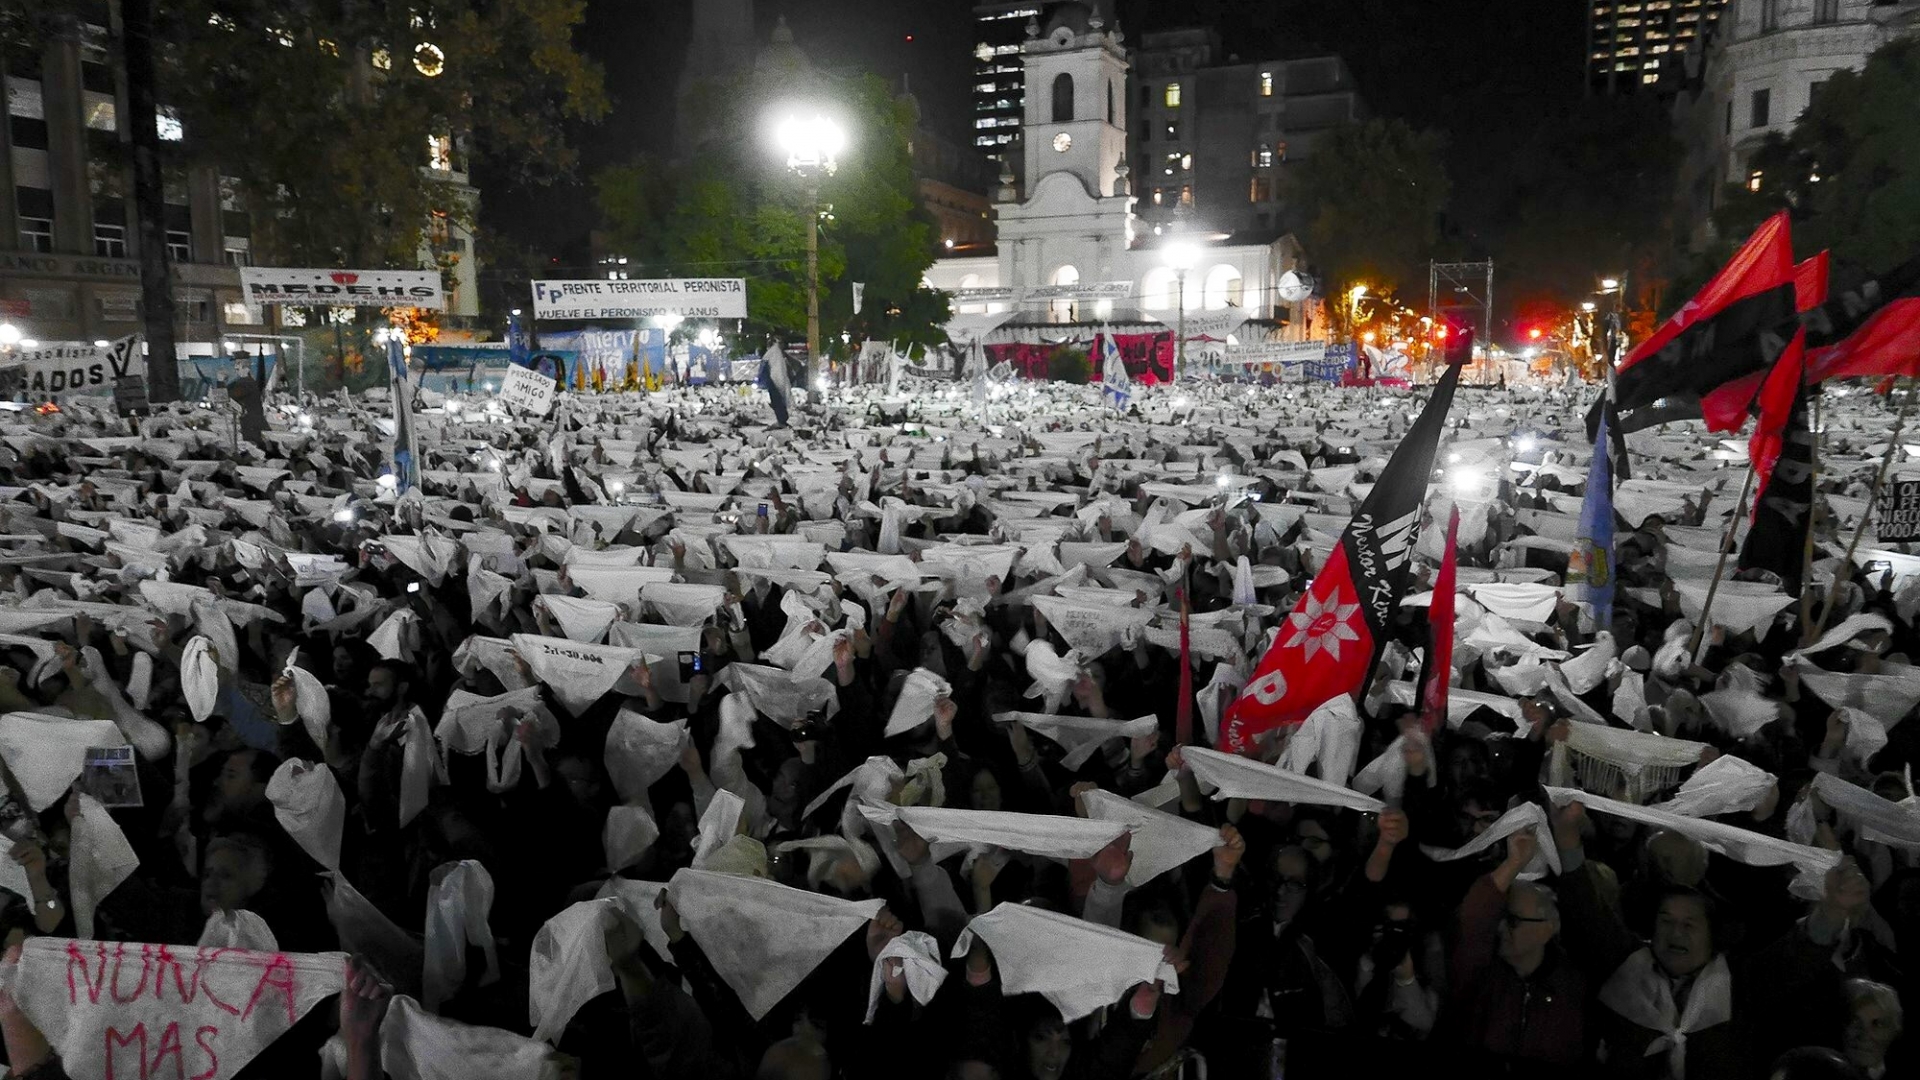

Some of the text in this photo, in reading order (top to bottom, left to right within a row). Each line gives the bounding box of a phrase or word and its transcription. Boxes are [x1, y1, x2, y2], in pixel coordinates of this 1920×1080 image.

[250, 283, 434, 297] MEDEHS
[562, 280, 741, 295] FRENTE TERRITORIAL PERONISTA
[538, 309, 580, 319] VUELVE
[584, 309, 597, 318] EL
[601, 307, 667, 317] PERONISMO
[681, 307, 719, 316] LANUS
[510, 369, 550, 389] PROCESADO
[513, 380, 545, 399] AMIGO
[527, 398, 535, 409] A
[1878, 483, 1894, 497] NI
[1878, 497, 1894, 510] NI
[1877, 510, 1892, 523] NI
[1351, 513, 1378, 578] Nestor
[65, 940, 296, 1024] NUNCA
[104, 1021, 218, 1080] MAS
